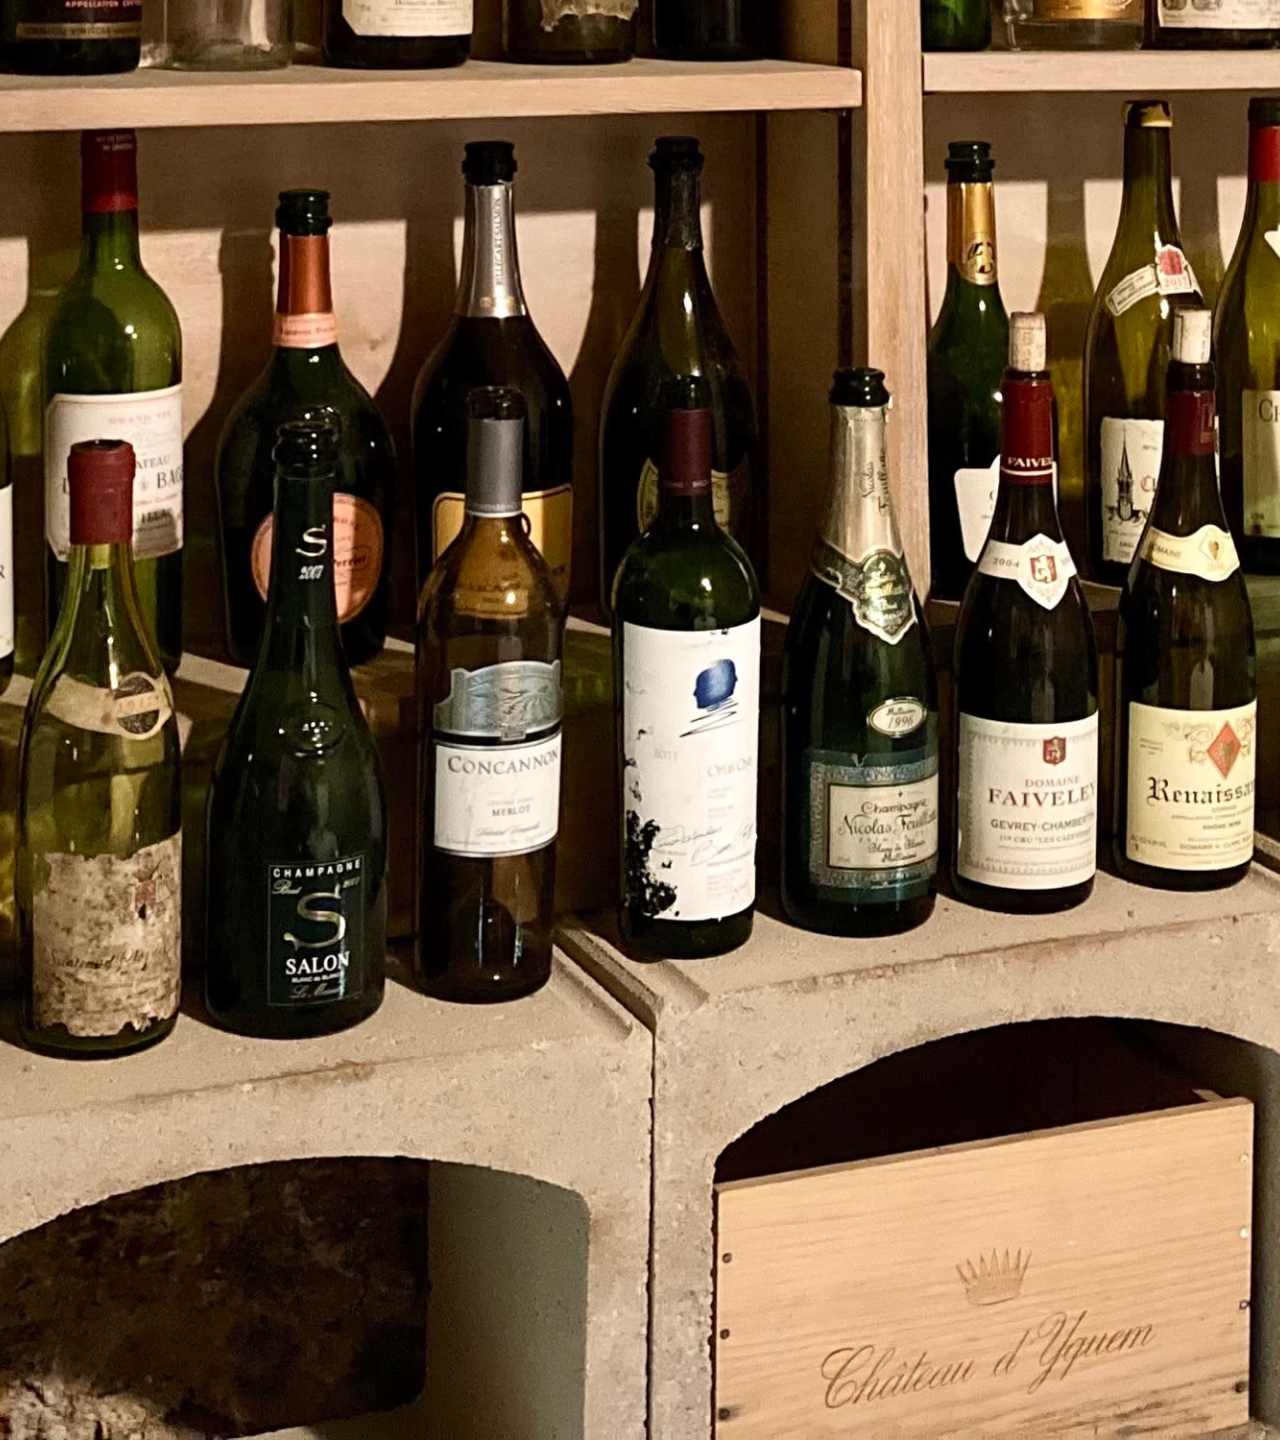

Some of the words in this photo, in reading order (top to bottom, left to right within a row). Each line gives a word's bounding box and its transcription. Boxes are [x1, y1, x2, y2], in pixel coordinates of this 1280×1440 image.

[296, 524, 328, 558] S
[298, 564, 326, 581] 2007
[447, 748, 559, 776] CONCANNON
[1024, 775, 1080, 788] DOMAINE
[988, 781, 1096, 808] FAIVELEY
[491, 804, 531, 818] MERLOT
[860, 798, 928, 817] Champagne
[837, 813, 892, 837] Nicolas
[273, 859, 361, 878] CHAMPAGNE
[283, 888, 347, 950] S
[285, 951, 350, 976] SALON
[820, 1342, 975, 1409] Château
[993, 1309, 1154, 1396] d'Yquem
